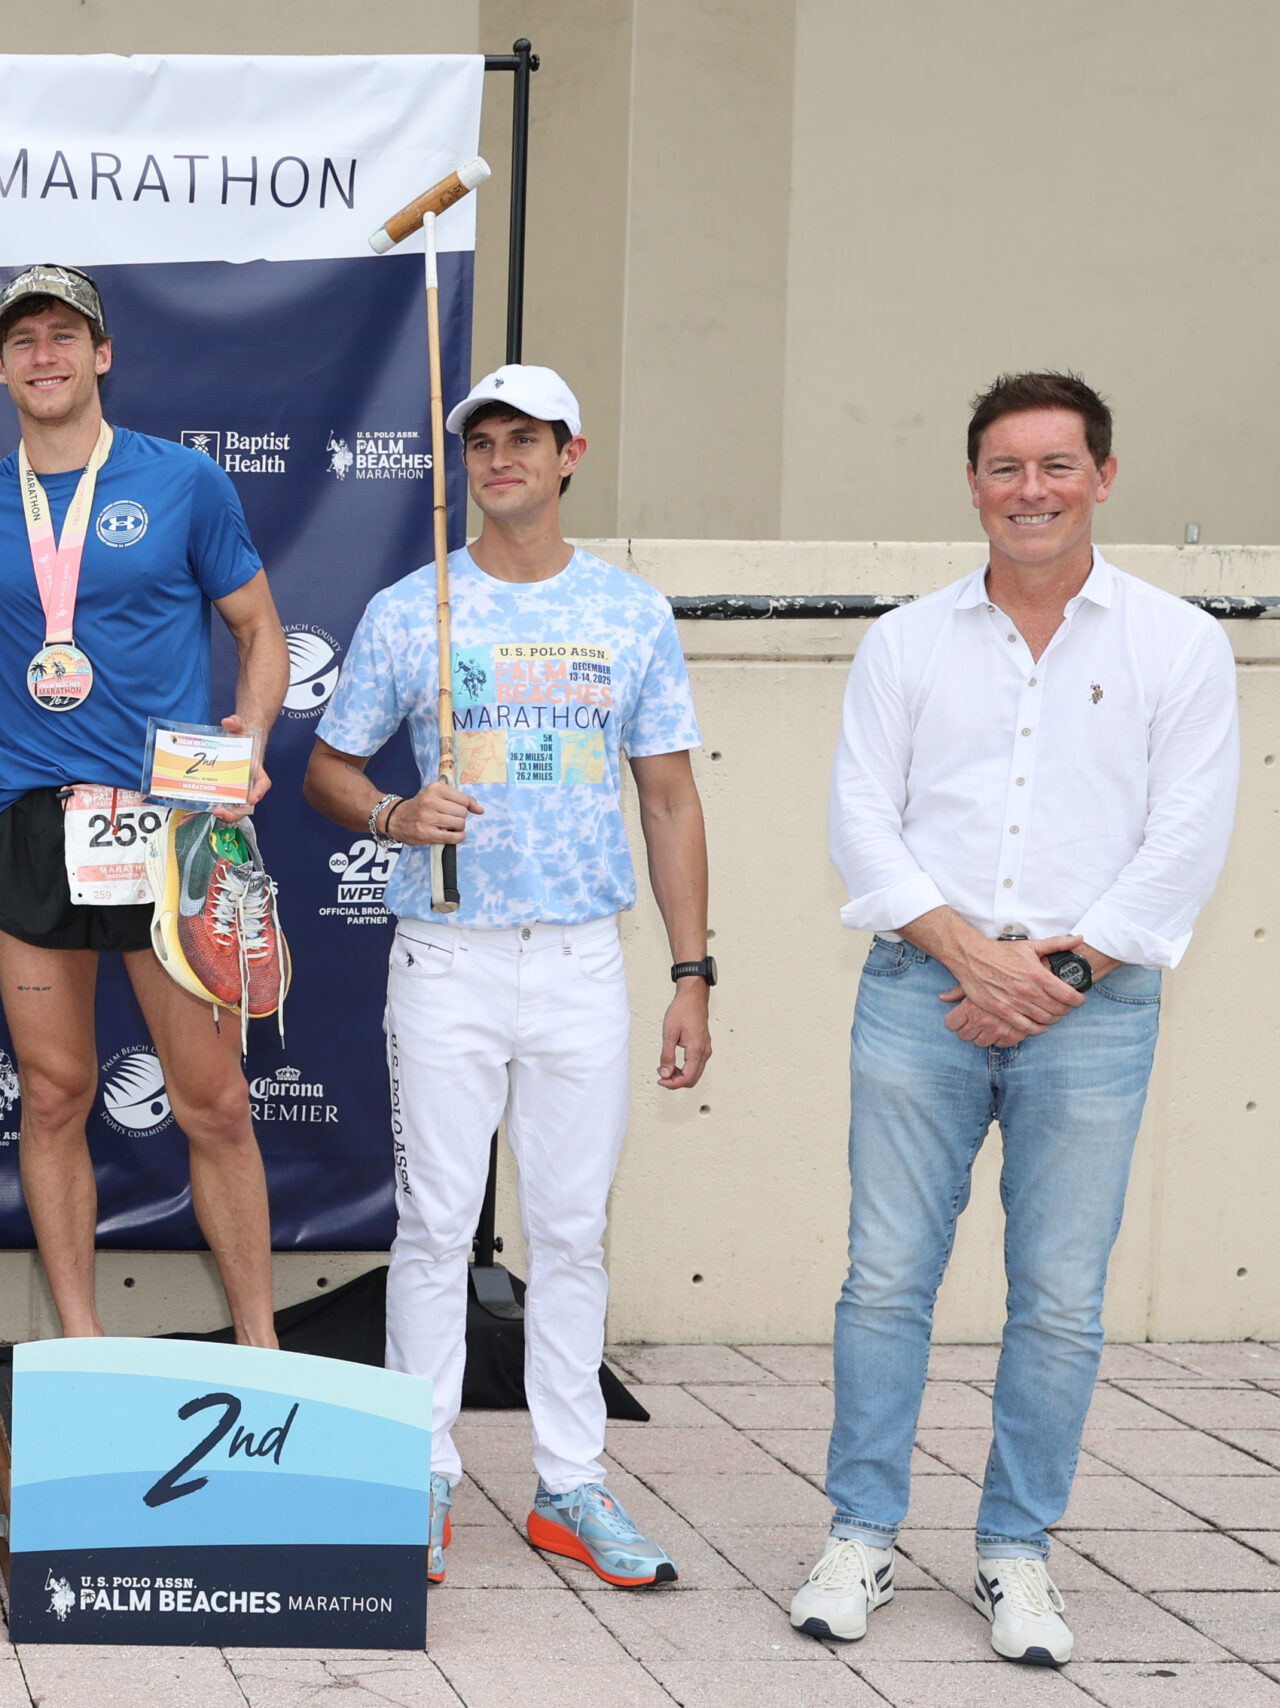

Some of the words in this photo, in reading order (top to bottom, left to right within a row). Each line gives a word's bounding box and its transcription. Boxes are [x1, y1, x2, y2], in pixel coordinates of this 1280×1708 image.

[397, 431, 421, 439] ASSN.
[224, 431, 291, 455] Baptist
[356, 439, 404, 454] PALM
[224, 454, 287, 474] Health
[356, 454, 433, 469] BEACHES
[355, 469, 424, 480] MARATHON
[25, 468, 41, 522] MARATHON
[310, 625, 343, 653] COUNTY
[530, 647, 567, 657] POLO
[570, 647, 609, 661] ASSN.
[494, 661, 567, 683] PALM
[572, 661, 612, 675] DECEMBER
[568, 671, 592, 683] 13-14,
[592, 673, 612, 686] 2025
[39, 687, 82, 696] MARATHON
[495, 683, 613, 708] BEACHES
[451, 704, 611, 731] MARATHON
[543, 733, 553, 743] 5K
[539, 743, 553, 752] 10K
[185, 751, 219, 775] 2nd
[510, 752, 524, 762] 26.2
[525, 752, 553, 762] MILES/4
[518, 762, 532, 772] 13.1
[532, 762, 553, 772] MILES
[516, 772, 531, 781] 26.2
[532, 772, 553, 781] MILES
[182, 782, 217, 792] MARATHON
[88, 811, 162, 848] 259
[330, 858, 348, 866] abc
[341, 839, 404, 882] 25
[99, 863, 146, 875] MARATH
[93, 890, 112, 899] 259
[318, 907, 360, 916] OFFICIAL
[346, 916, 388, 925] PARTNER
[101, 1053, 121, 1072] PALM
[121, 1045, 149, 1056] BEACH
[249, 1076, 324, 1102] Corona
[100, 1111, 126, 1135] SPORTS
[142, 1391, 300, 1509] 2nd
[112, 1576, 152, 1589] POLO
[154, 1576, 198, 1590] ASSN.
[79, 1589, 151, 1612] PALM
[158, 1589, 282, 1615] BEACHES
[288, 1595, 393, 1613] MARATHON
